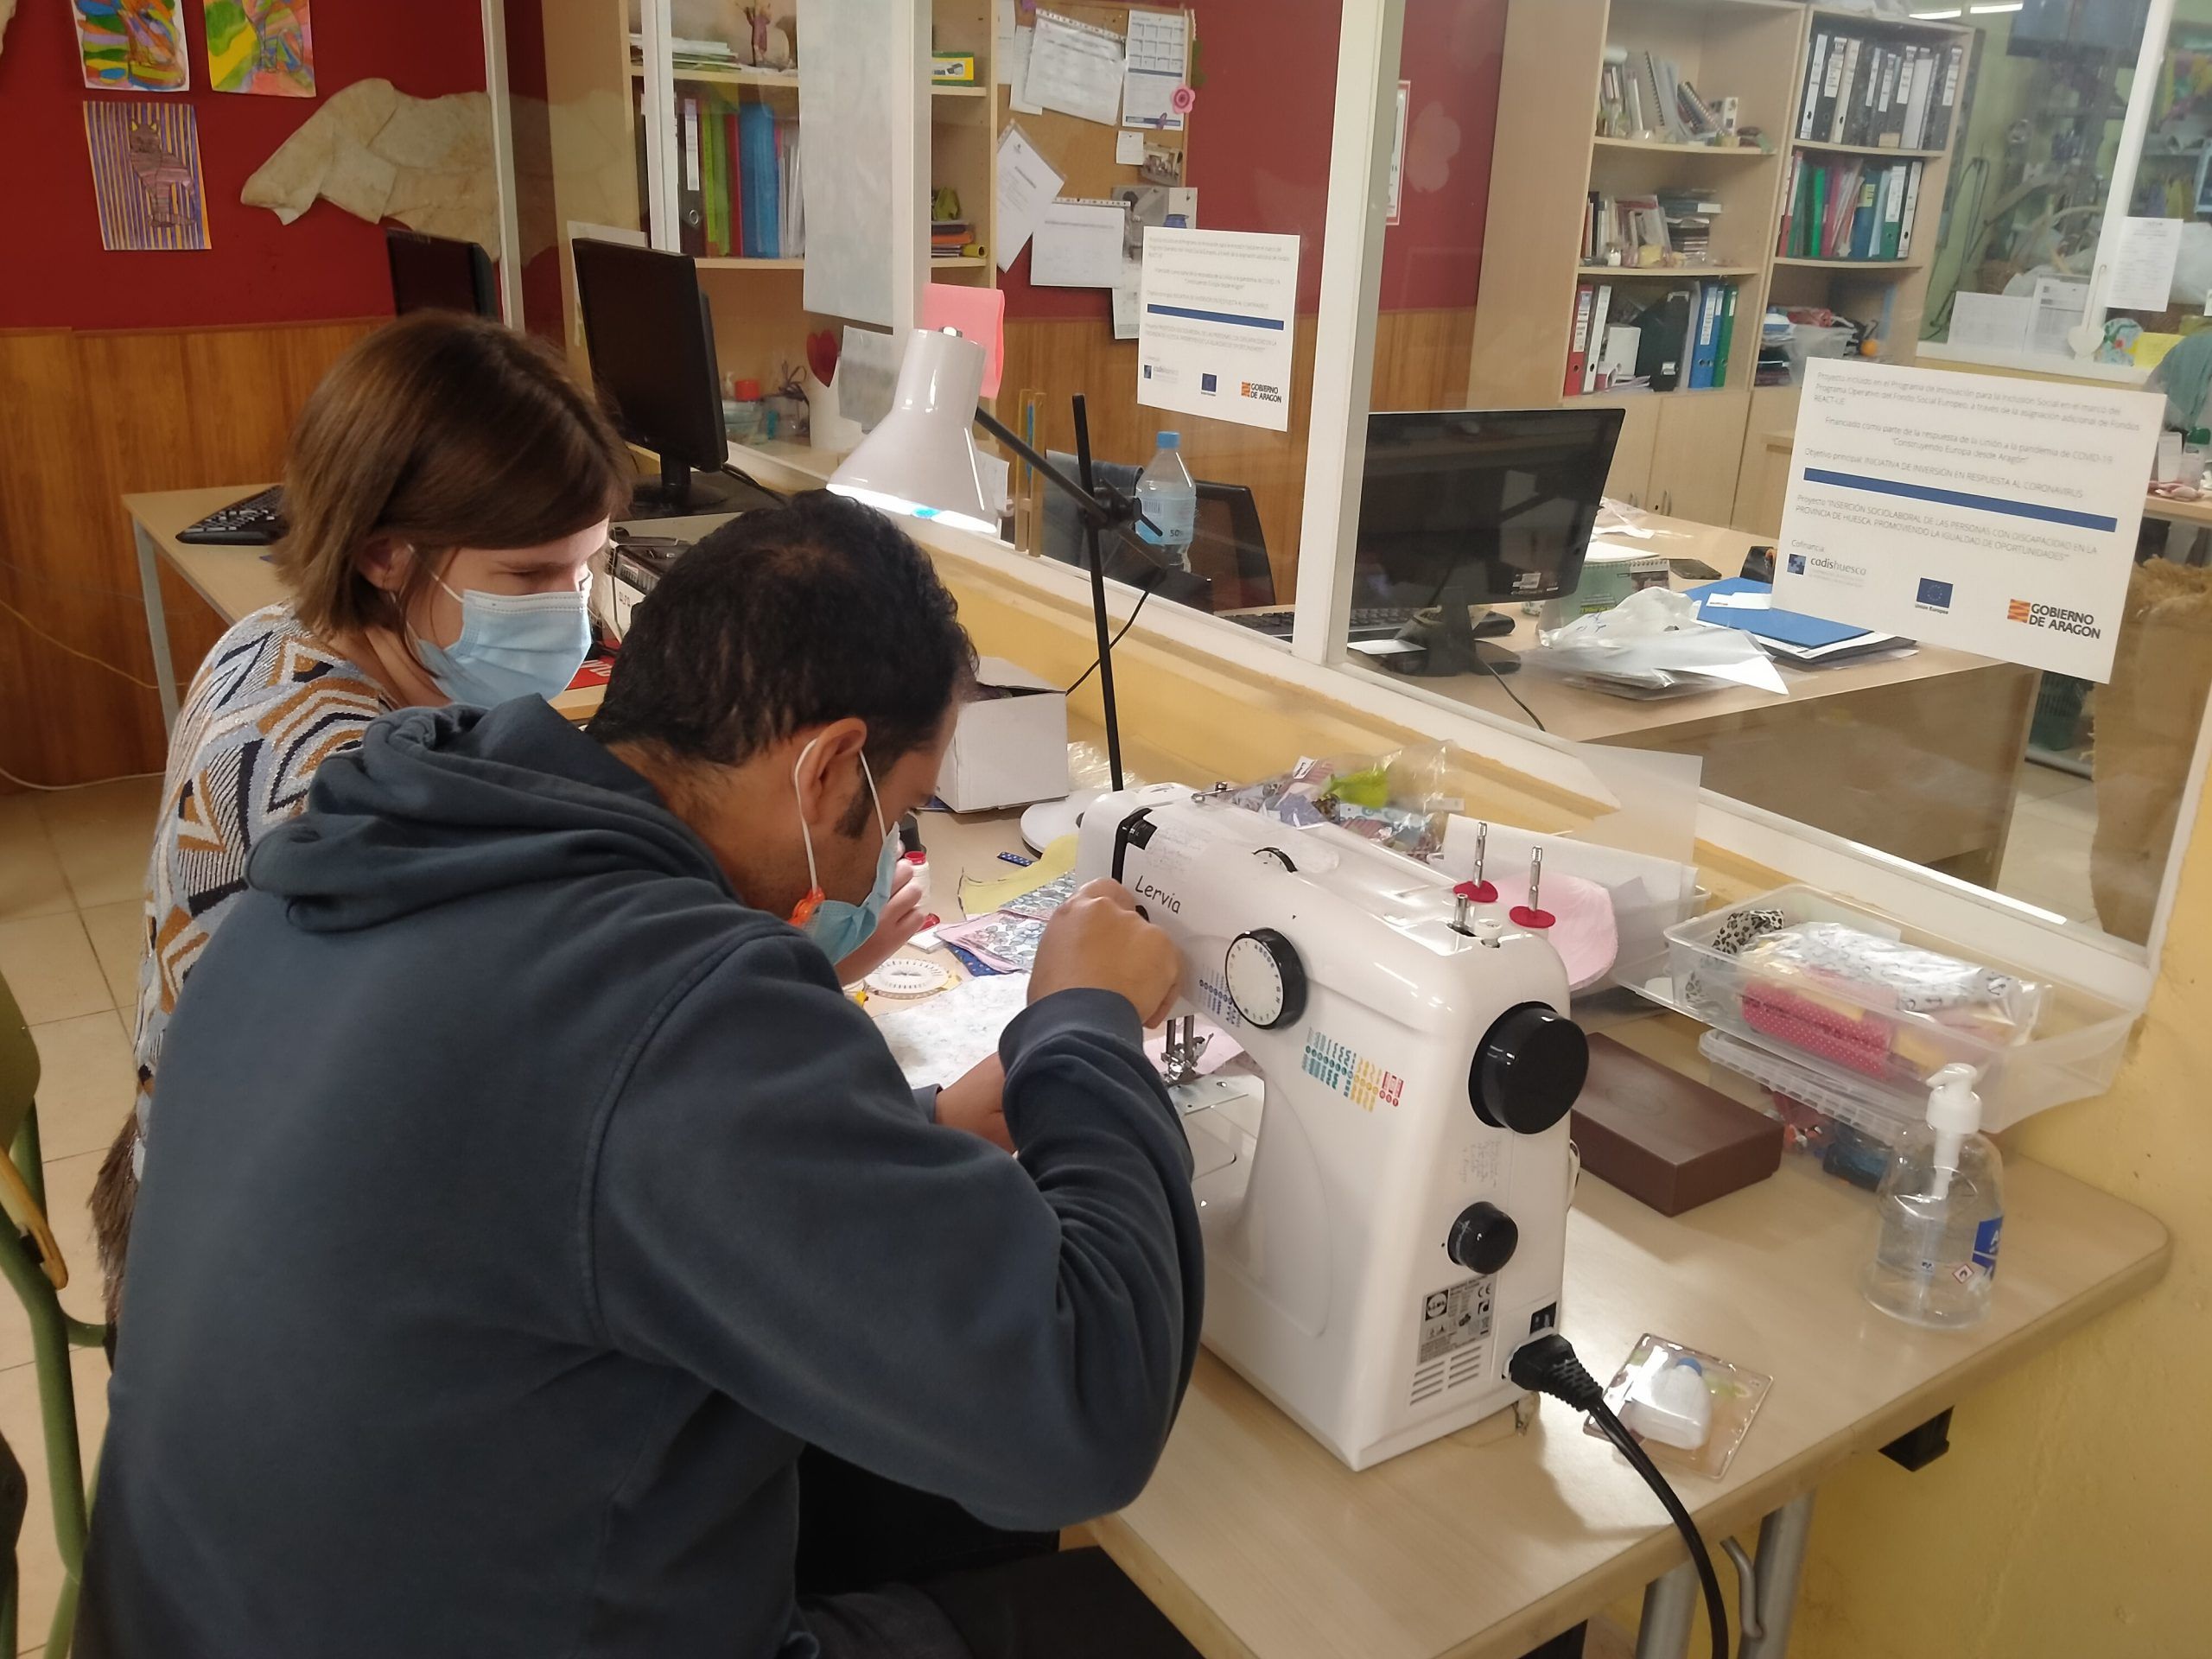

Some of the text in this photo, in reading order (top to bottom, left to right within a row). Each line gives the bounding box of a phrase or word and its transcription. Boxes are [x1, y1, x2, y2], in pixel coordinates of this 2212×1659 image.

[1250, 391, 1258, 399] DE
[1815, 384, 1846, 394] Programa
[1893, 393, 1915, 402] Fondo
[1916, 396, 1936, 405] Social
[2098, 418, 2107, 427] de
[1883, 425, 1901, 434] parte
[1922, 430, 1958, 442] respuesta
[2019, 444, 2058, 456] pandemia
[2060, 449, 2070, 458] de
[1945, 446, 1971, 457] Europa
[1974, 449, 1996, 459] desde
[1865, 457, 1900, 469] INICIATIVA
[1901, 462, 1911, 471] DE
[1955, 471, 1965, 480] EN
[1967, 473, 2011, 486] RESPUESTA
[2012, 480, 2021, 488] AL
[2024, 481, 2083, 498] CORONAVIRUS
[1796, 505, 1831, 518] PROVINCIA
[1833, 512, 1841, 520] DE
[1931, 530, 1940, 538] LA
[1941, 531, 1980, 545] IGUALDAD
[1983, 539, 1993, 548] DE
[1797, 494, 1825, 505] Proyecto
[1936, 518, 1948, 527] LAS
[1951, 521, 1991, 535] PERSONAS
[1993, 528, 2010, 538] CON
[2028, 614, 2101, 639] DE ARAGON
[2031, 602, 2094, 626] GOBIERNO
[1135, 874, 1181, 914] Lervia
